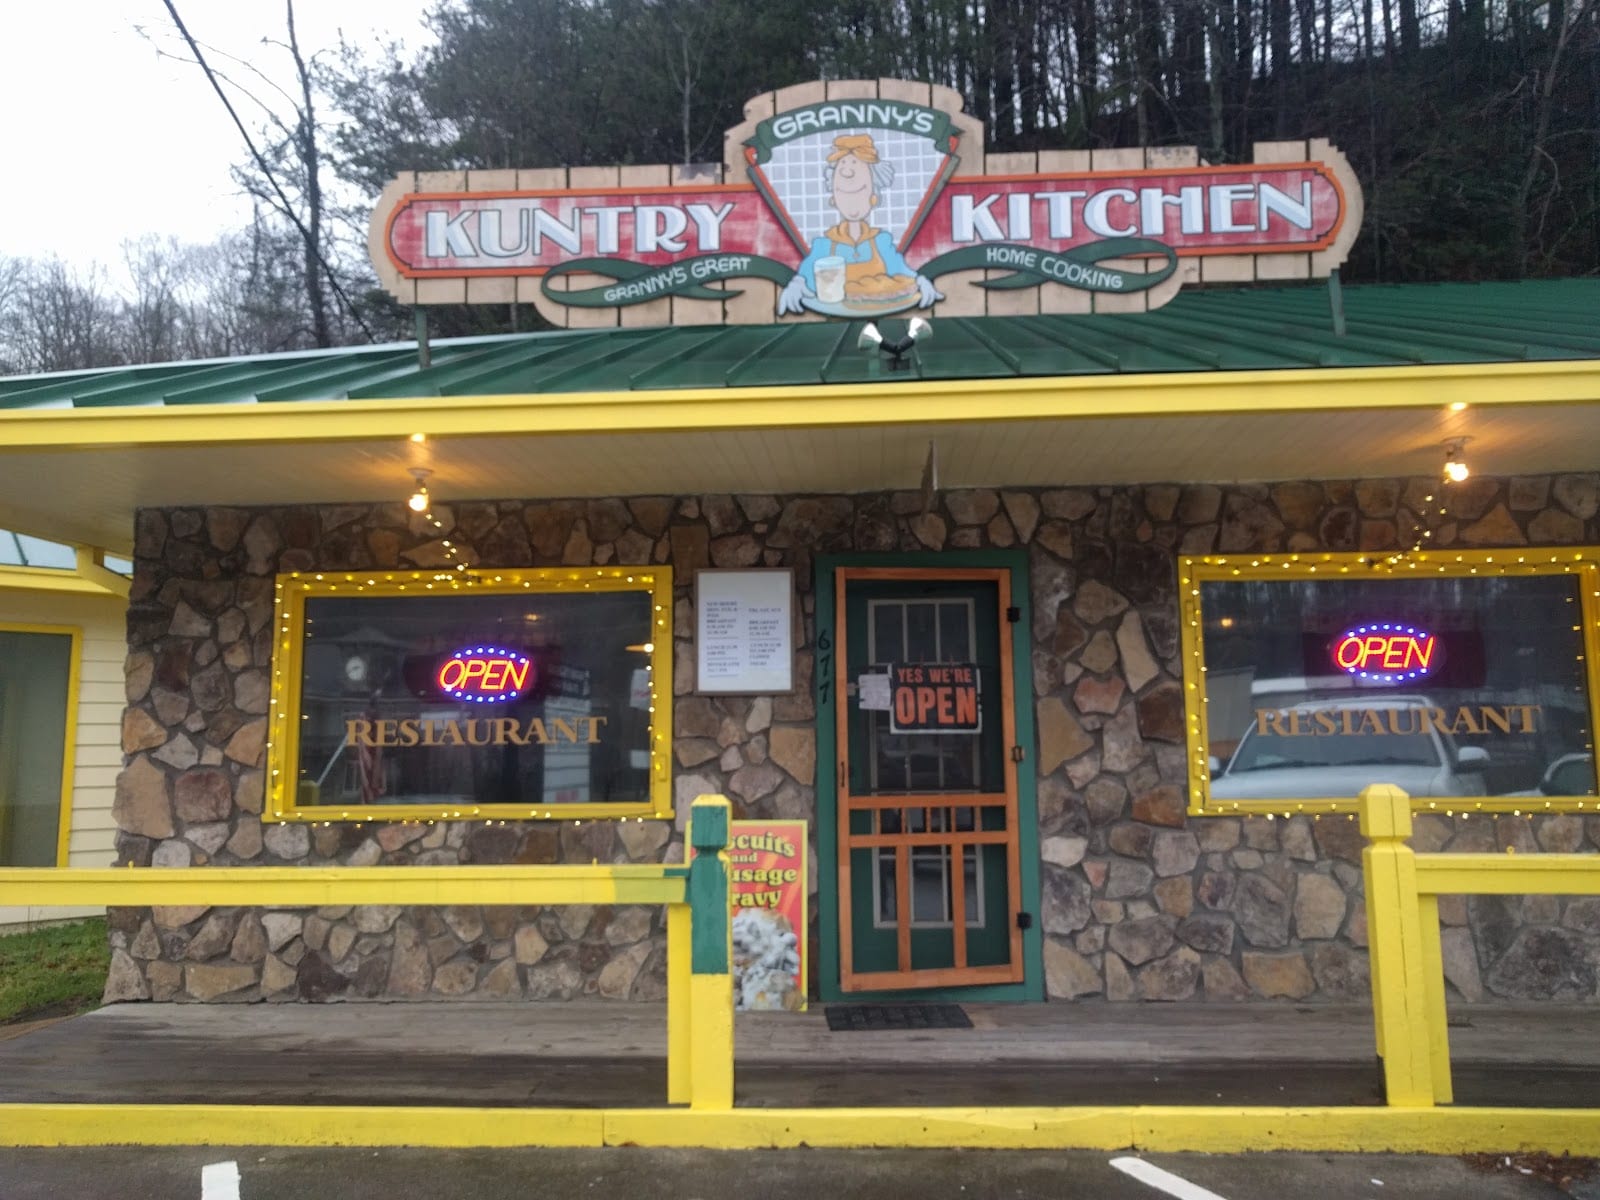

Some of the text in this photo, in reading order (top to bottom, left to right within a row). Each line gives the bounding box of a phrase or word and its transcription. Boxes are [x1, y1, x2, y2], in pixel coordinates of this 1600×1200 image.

[772, 104, 935, 139] GRANNY'S
[425, 180, 1314, 258] KUNTRY KITCHEN
[603, 256, 752, 302] GRANNY'S GREAT
[986, 247, 1124, 289] HOME COOKING
[1337, 636, 1434, 669] OPEN
[439, 659, 530, 690] OPEN
[897, 667, 973, 684] YES WE'RE
[895, 686, 977, 725] OPEN
[1255, 704, 1543, 737] RESTAURANT
[344, 716, 608, 747] RESTAURANT
[732, 890, 782, 909] ravy
